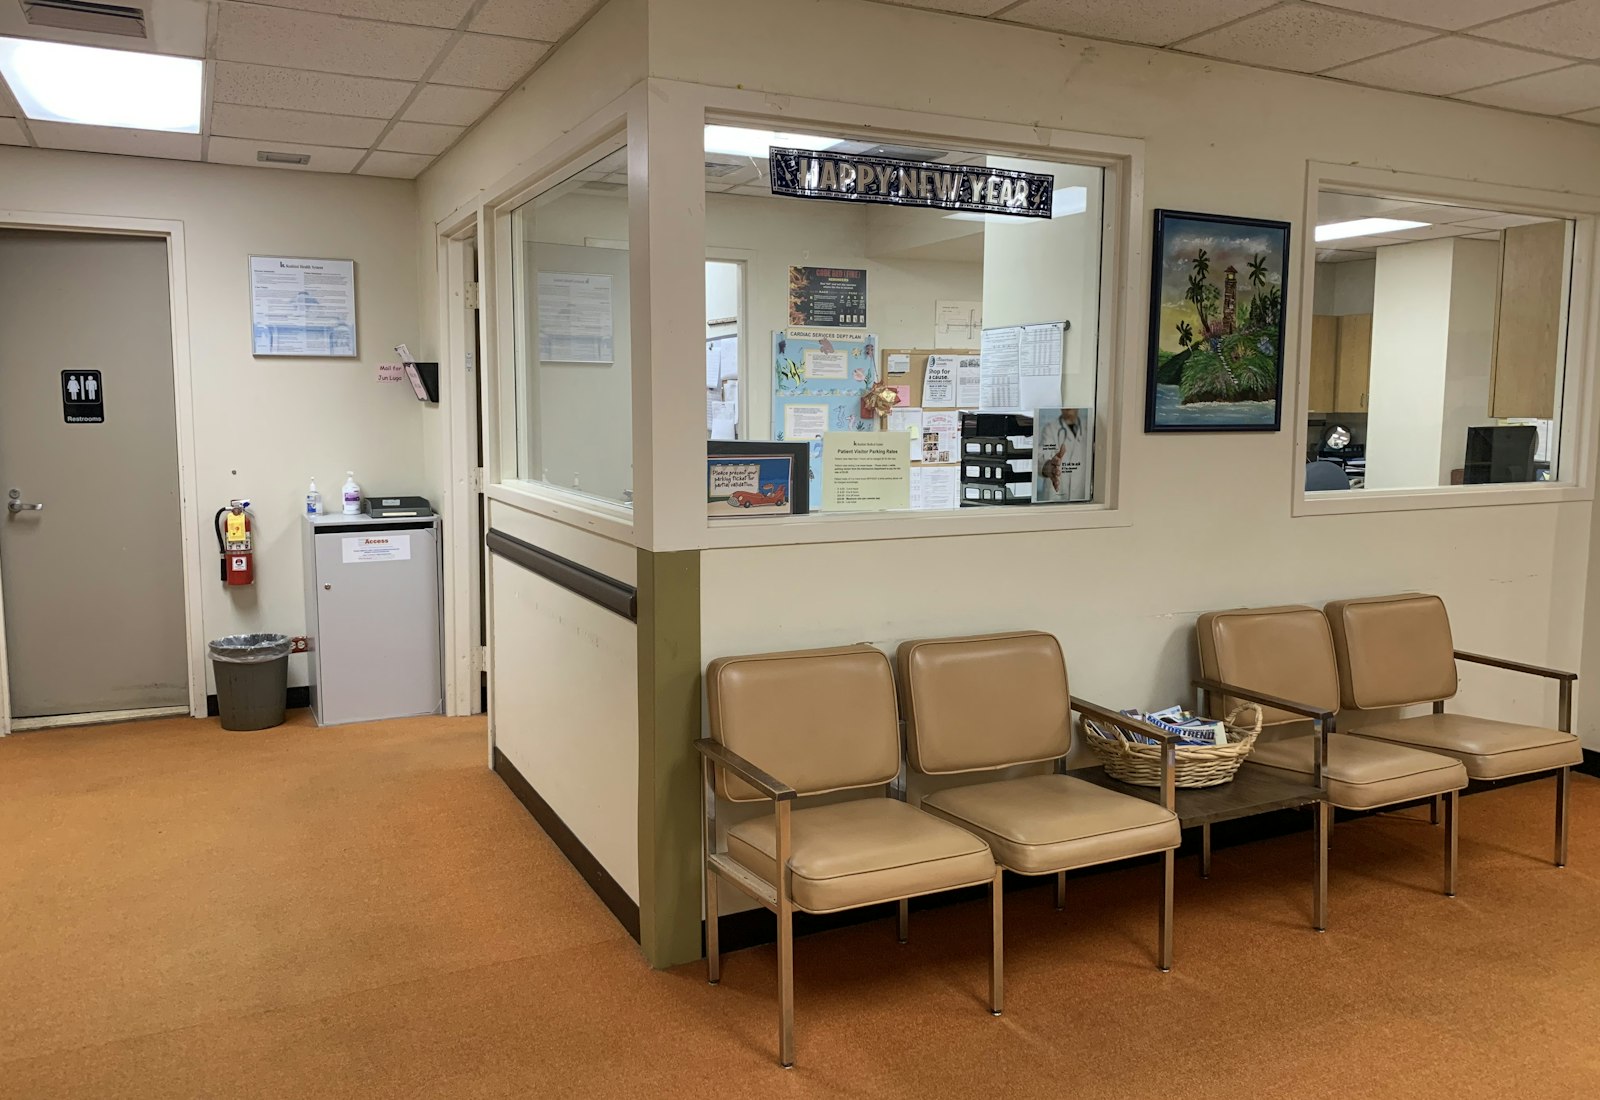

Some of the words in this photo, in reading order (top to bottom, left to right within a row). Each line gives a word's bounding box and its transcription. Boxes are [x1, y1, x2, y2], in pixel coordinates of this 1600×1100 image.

[799, 157, 893, 195] HAPPY
[898, 167, 963, 201] NEW
[968, 173, 1030, 208] YEAR
[714, 476, 731, 484] parking
